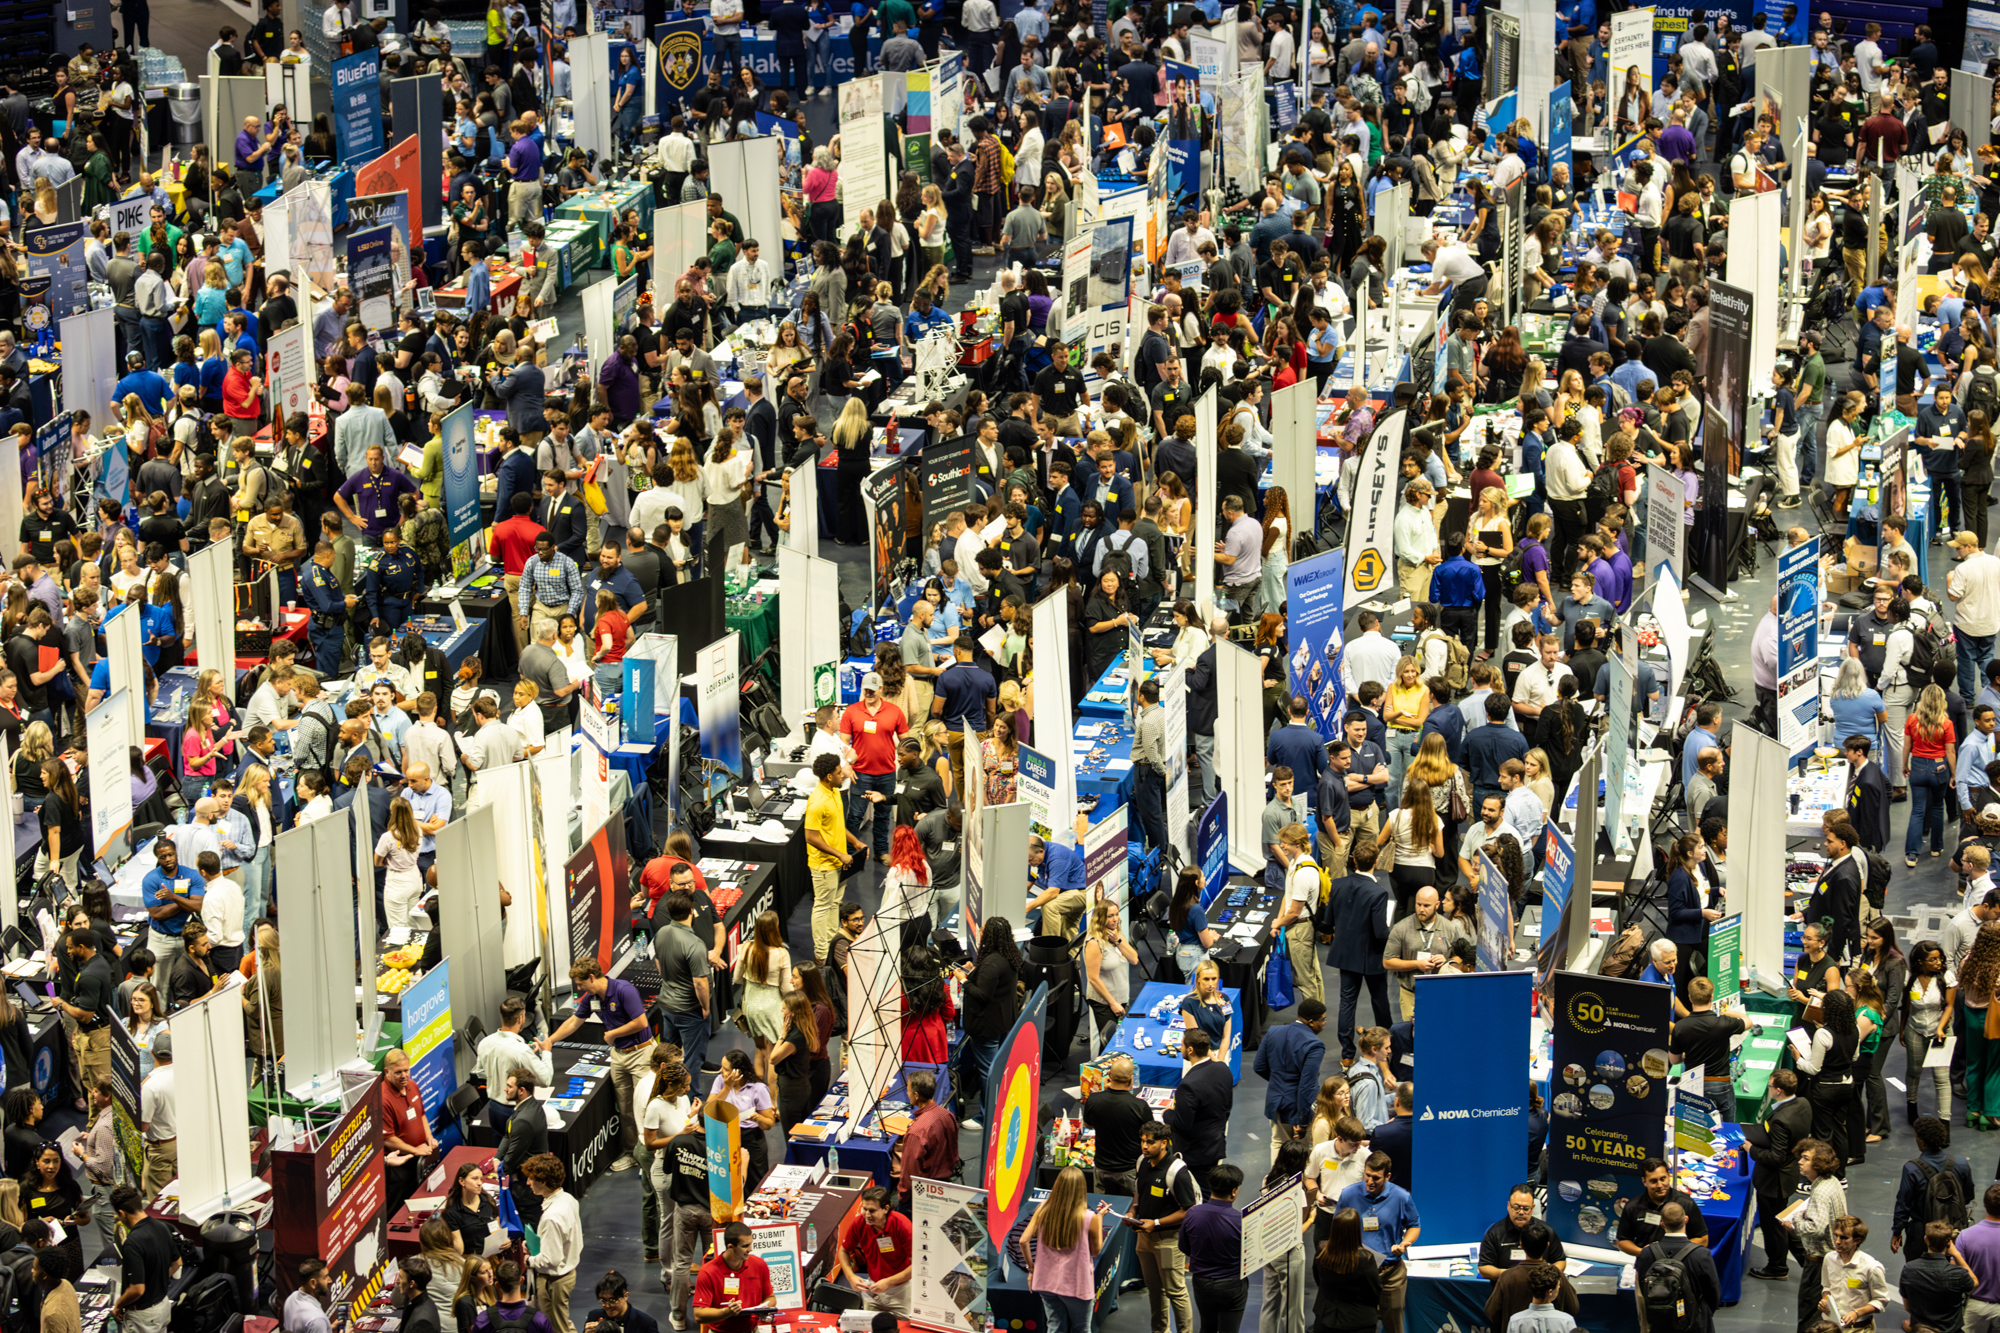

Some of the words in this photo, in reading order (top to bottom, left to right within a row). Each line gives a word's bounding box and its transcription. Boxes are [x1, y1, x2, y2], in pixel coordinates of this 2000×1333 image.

[1704, 8, 1738, 19] orld's
[1614, 33, 1645, 46] CERTAINTY
[1614, 43, 1634, 54] STARTS
[117, 205, 143, 231] PIKE
[376, 203, 400, 218] Law
[369, 239, 384, 250] Online
[1094, 320, 1121, 339] CIS
[937, 463, 971, 483] Southland
[1365, 434, 1389, 543] LIPSEY'S
[1649, 518, 1655, 527] TO
[1656, 521, 1667, 535] MAKE
[1668, 528, 1676, 540] THE
[1649, 526, 1662, 540] WORLD
[1662, 534, 1675, 548] BETTER
[1648, 535, 1657, 545] FOR
[1792, 572, 1817, 585] CAREER
[706, 672, 735, 695] LOUISIANA
[1025, 760, 1047, 779] CAREER
[1027, 754, 1042, 766] BUILD
[1042, 761, 1047, 769] A
[1025, 781, 1040, 795] Globe
[1040, 789, 1050, 800] Life
[1034, 802, 1048, 815] FROM
[740, 884, 774, 941] LANDIS
[407, 989, 445, 1029] hargrove
[1577, 1002, 1604, 1023] 50
[1605, 1010, 1641, 1020] ANNIVERSARY
[1613, 1022, 1630, 1030] NOVA
[1630, 1024, 1657, 1033] Chemicals
[410, 1043, 422, 1059] Join
[421, 1032, 433, 1048] Our
[432, 1020, 451, 1039] Team
[1679, 1092, 1712, 1110] Engineering
[1438, 1109, 1470, 1120] NOVA
[1683, 1112, 1708, 1127] Engineering
[1685, 1108, 1705, 1119] Chemical
[330, 1104, 368, 1159] ELECTRIFY
[1584, 1126, 1628, 1142] Celebrating
[326, 1147, 345, 1179] YOUR
[345, 1116, 372, 1156] FUTURE
[572, 1115, 620, 1182] hargrove
[1565, 1134, 1587, 1151] 50
[1591, 1138, 1646, 1161] YEARS
[682, 1150, 705, 1164] HAPPY
[1572, 1152, 1580, 1161] in
[1581, 1153, 1639, 1170] Petrochemicals
[926, 1184, 944, 1196] IDS
[926, 1193, 949, 1203] Engineering
[948, 1197, 960, 1205] Group
[758, 1230, 786, 1240] SUBMIT
[752, 1240, 783, 1250] RESUME
[330, 1269, 348, 1303] 25+
